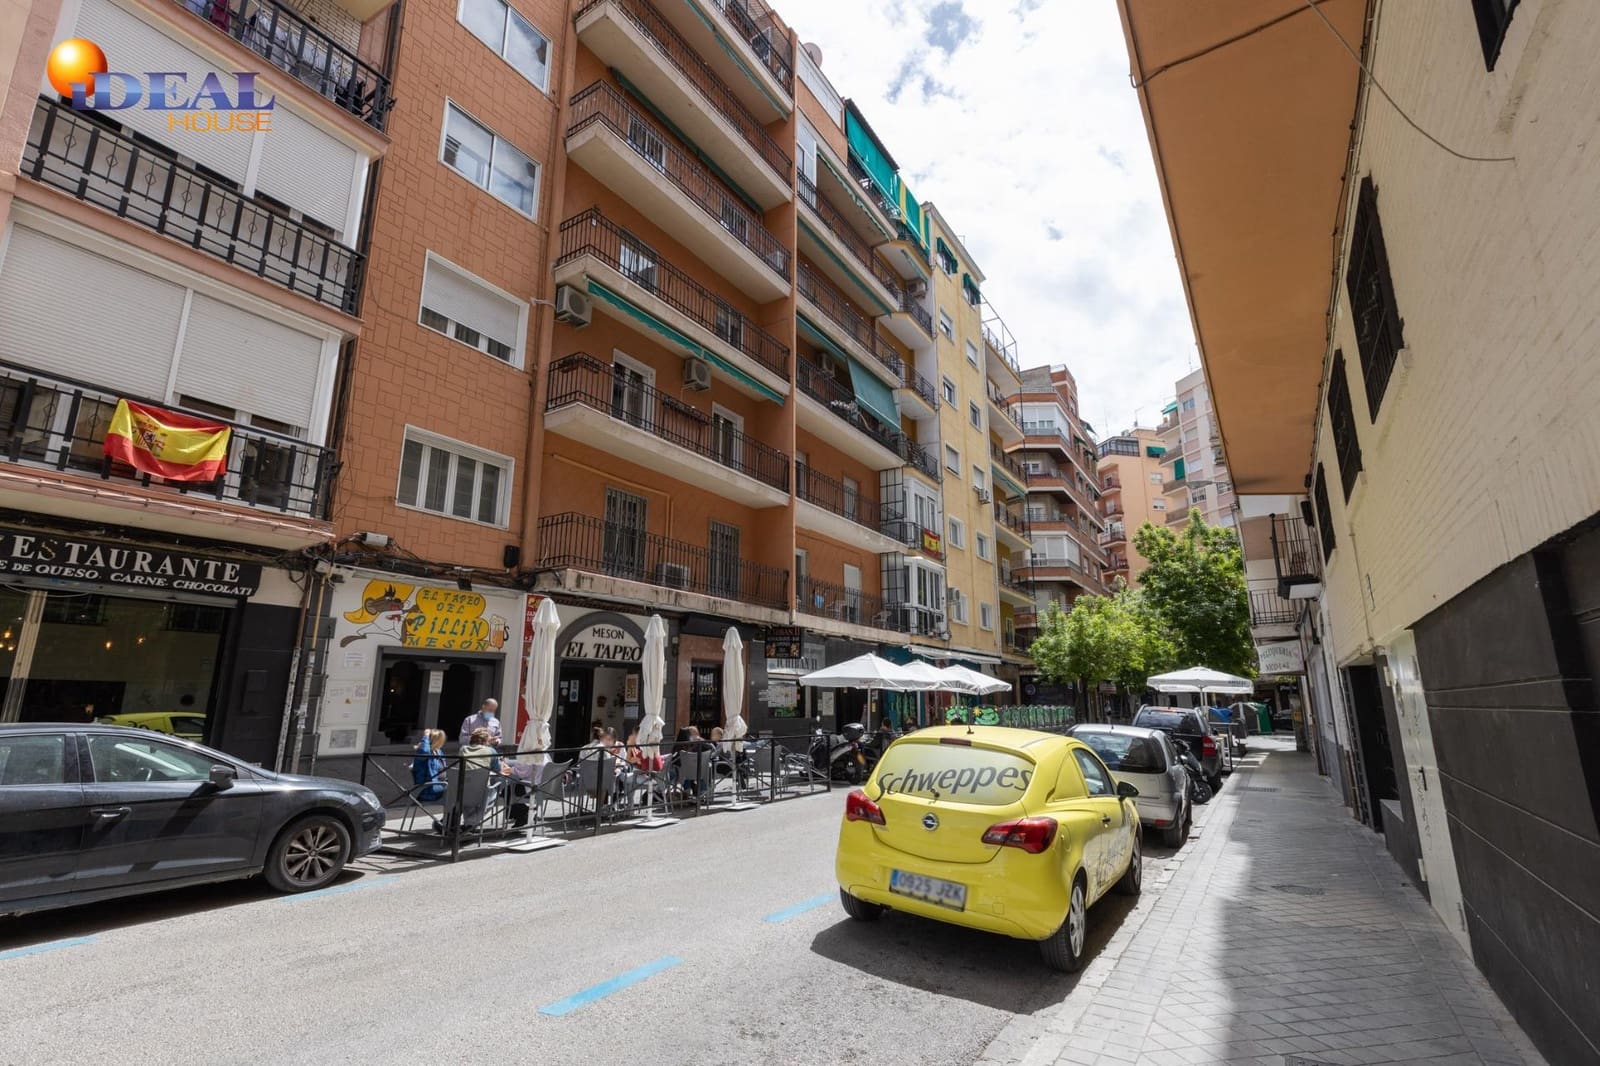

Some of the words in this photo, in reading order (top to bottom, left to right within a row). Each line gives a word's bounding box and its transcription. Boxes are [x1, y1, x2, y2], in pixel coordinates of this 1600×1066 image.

[0, 534, 240, 583] ESTAURANTE
[12, 562, 33, 572] DE
[422, 589, 439, 601] EL
[443, 592, 481, 606] TAPEO
[592, 627, 625, 639] MESON
[407, 636, 490, 651] MESON
[566, 641, 588, 658] EL
[593, 643, 643, 662] TAPEO
[873, 766, 1034, 802] Schweppes
